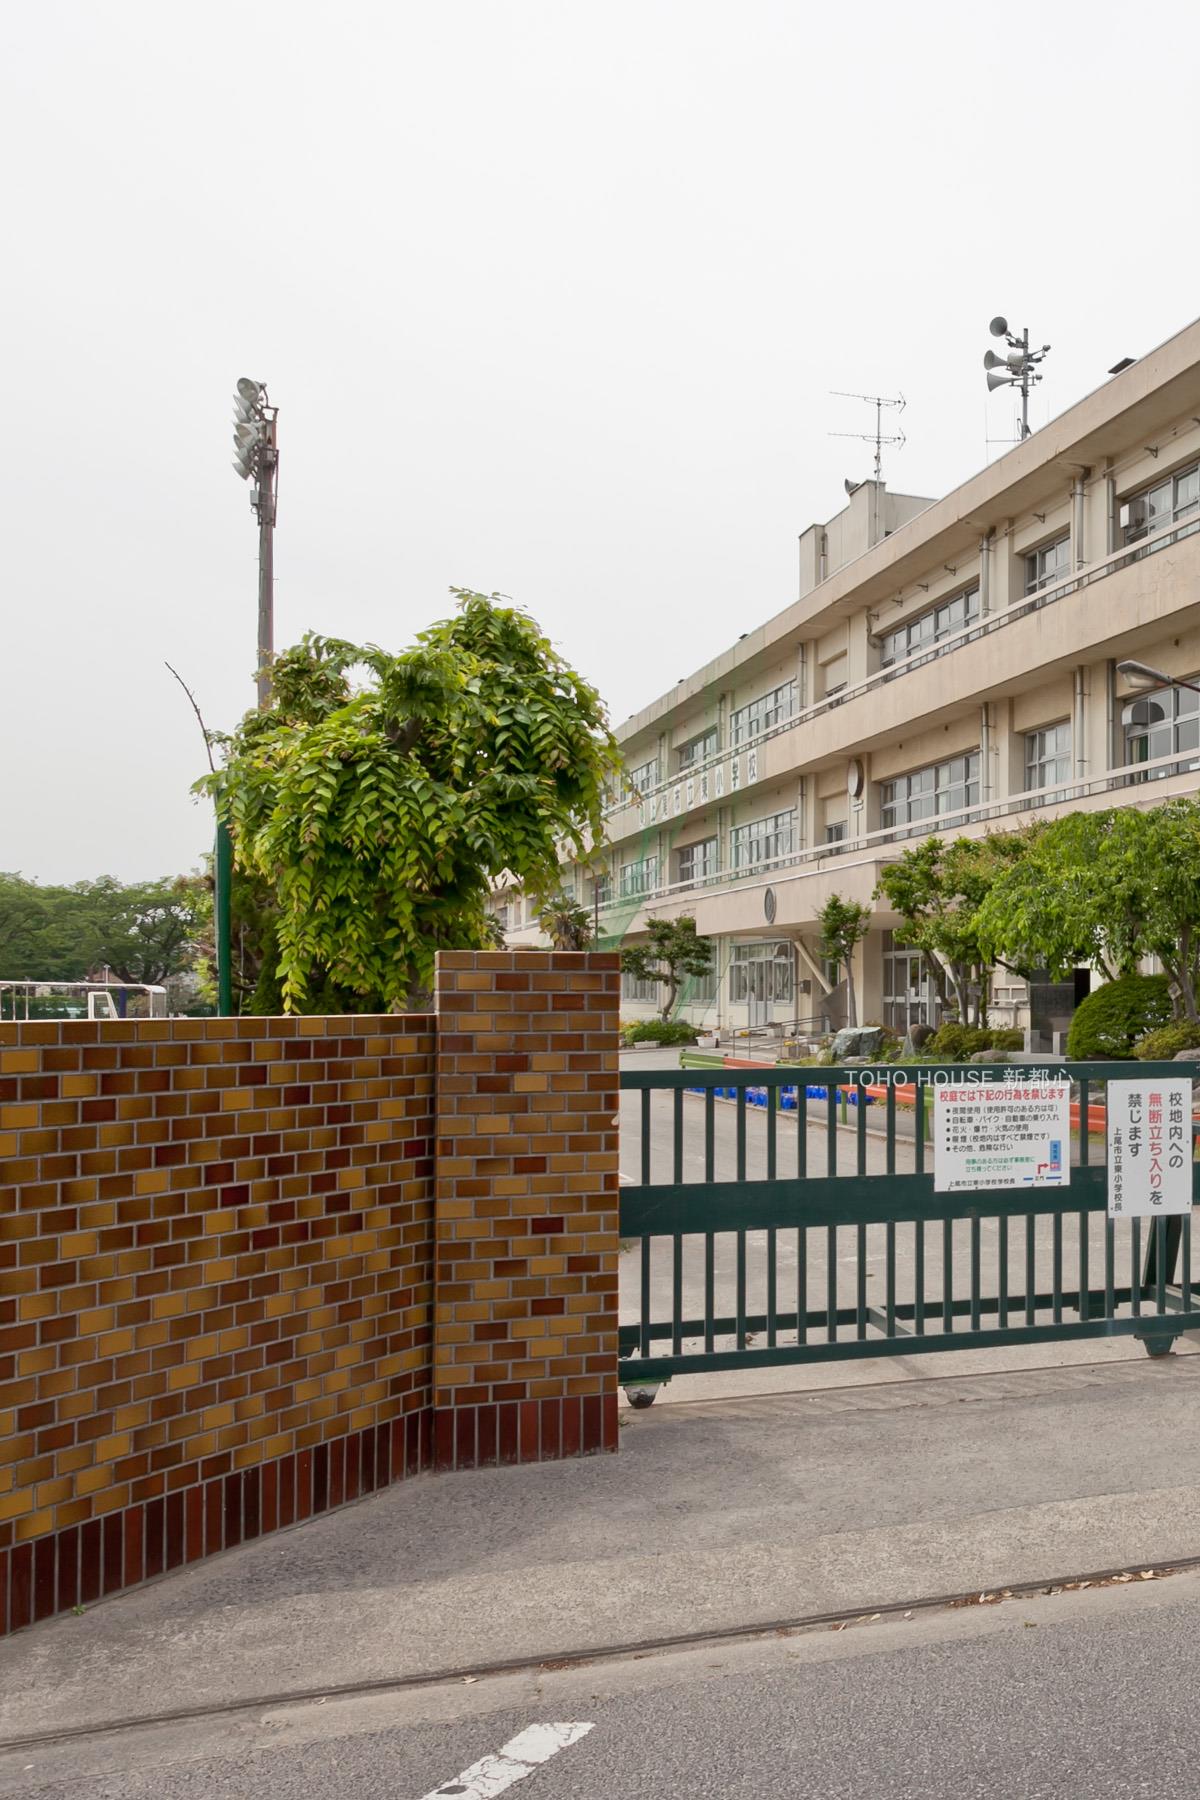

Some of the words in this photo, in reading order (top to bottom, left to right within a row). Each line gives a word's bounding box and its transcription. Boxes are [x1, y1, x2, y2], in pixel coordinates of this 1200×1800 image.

[940, 1088, 1065, 1102] 校庭では下記の行為を禁じます
[1128, 1093, 1142, 1157] 禁じます
[1168, 1092, 1183, 1168] 校地内への
[1113, 1127, 1122, 1211] 上尾市立東小学校長
[1148, 1093, 1163, 1205] 無断立ち入りを
